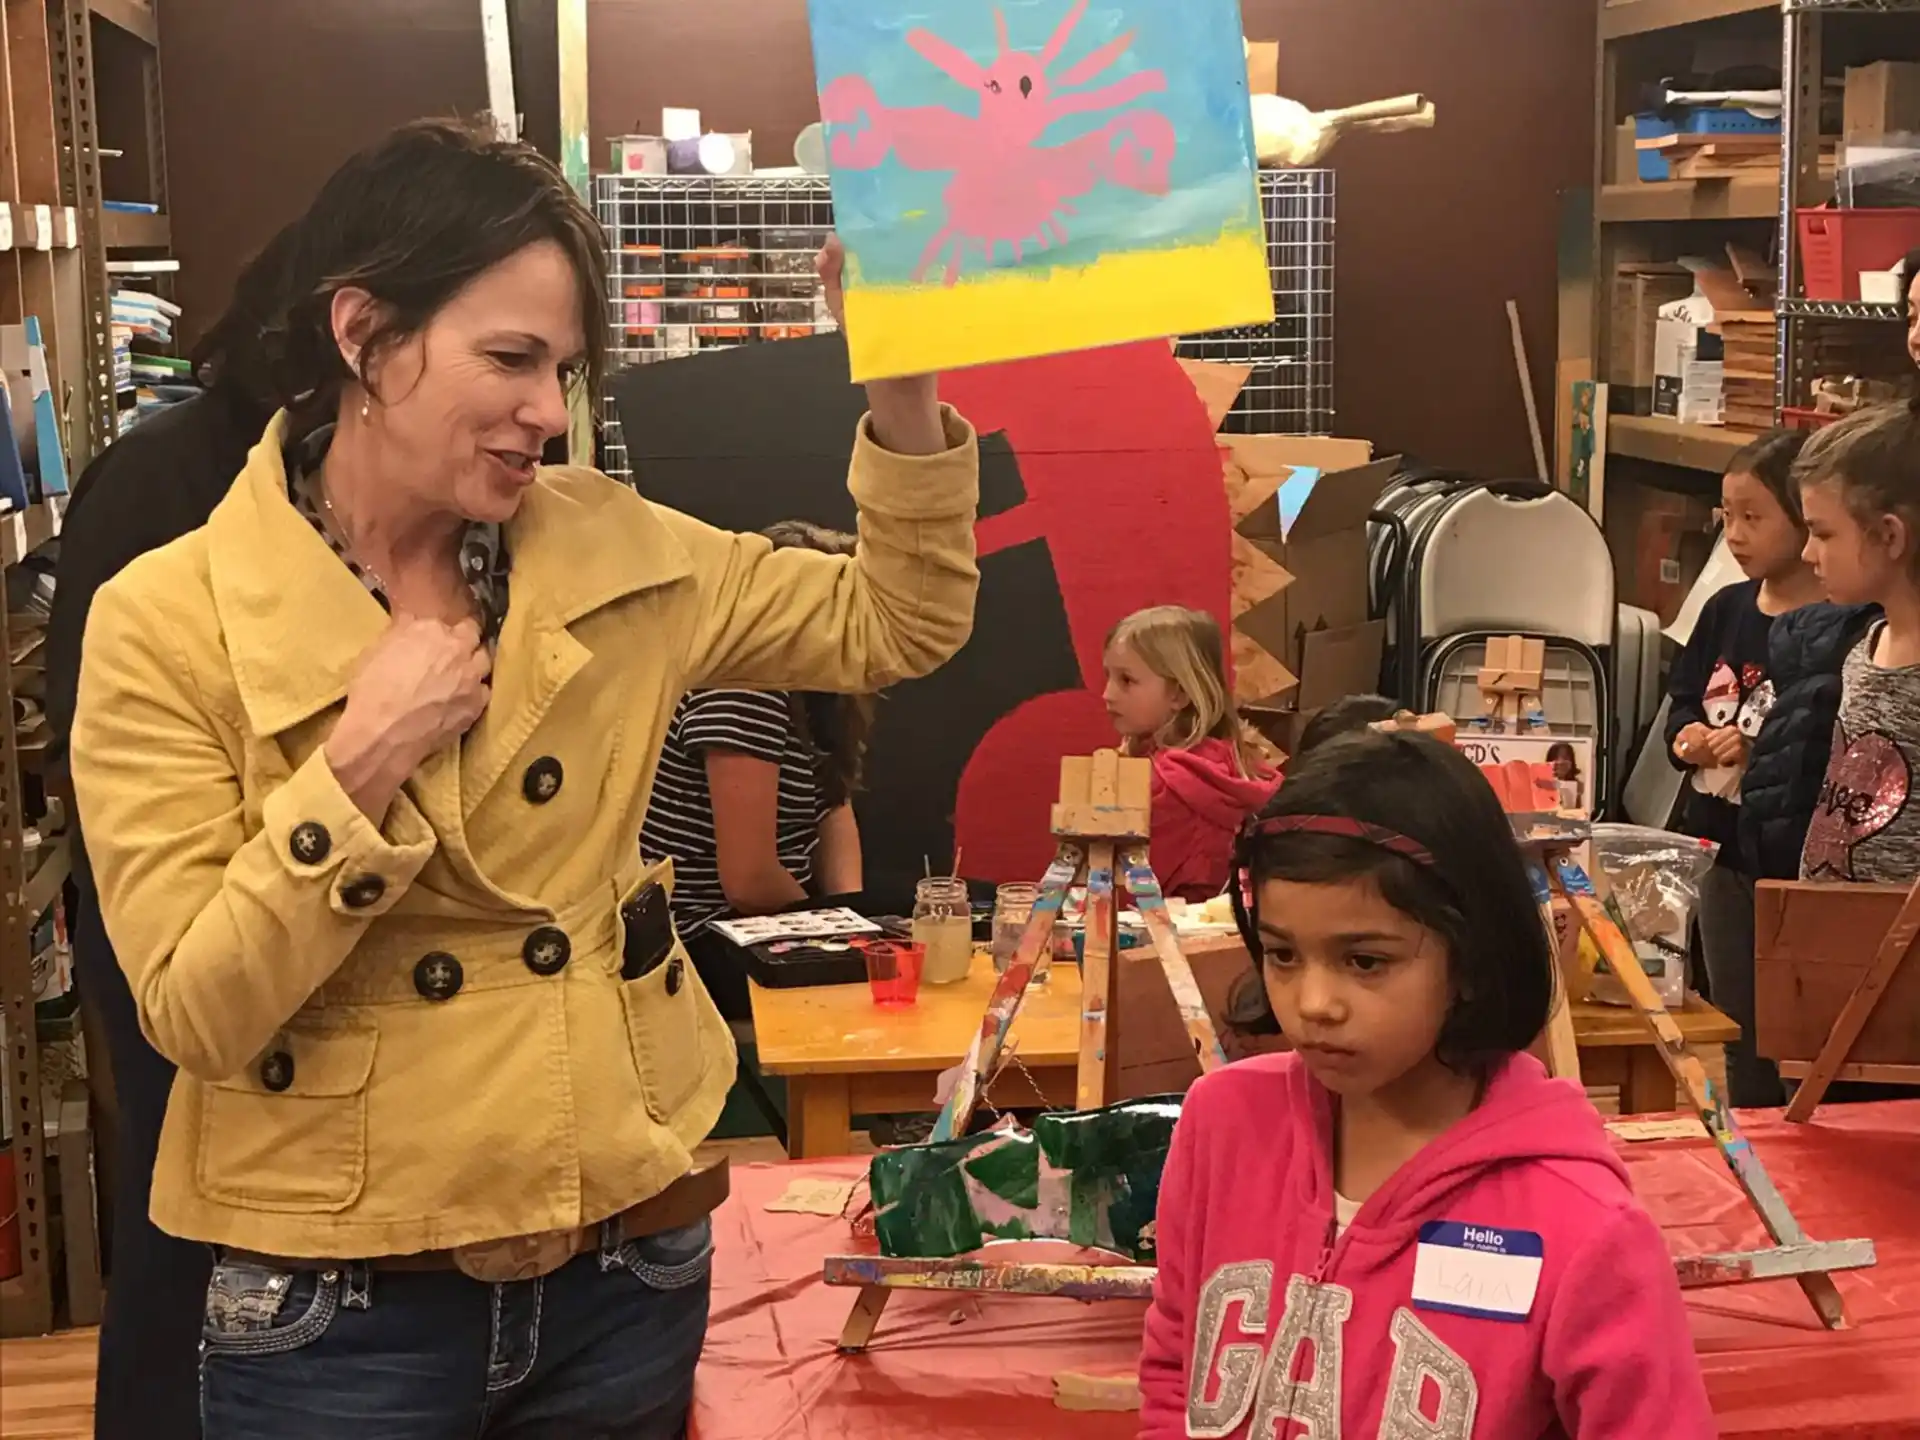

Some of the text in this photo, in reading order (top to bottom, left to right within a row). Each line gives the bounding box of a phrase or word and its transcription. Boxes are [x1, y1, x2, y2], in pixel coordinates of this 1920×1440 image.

[1463, 1226, 1504, 1246] Hello
[1463, 1241, 1475, 1249] my
[1476, 1243, 1498, 1253] name
[1185, 1258, 1478, 1440] GAP
